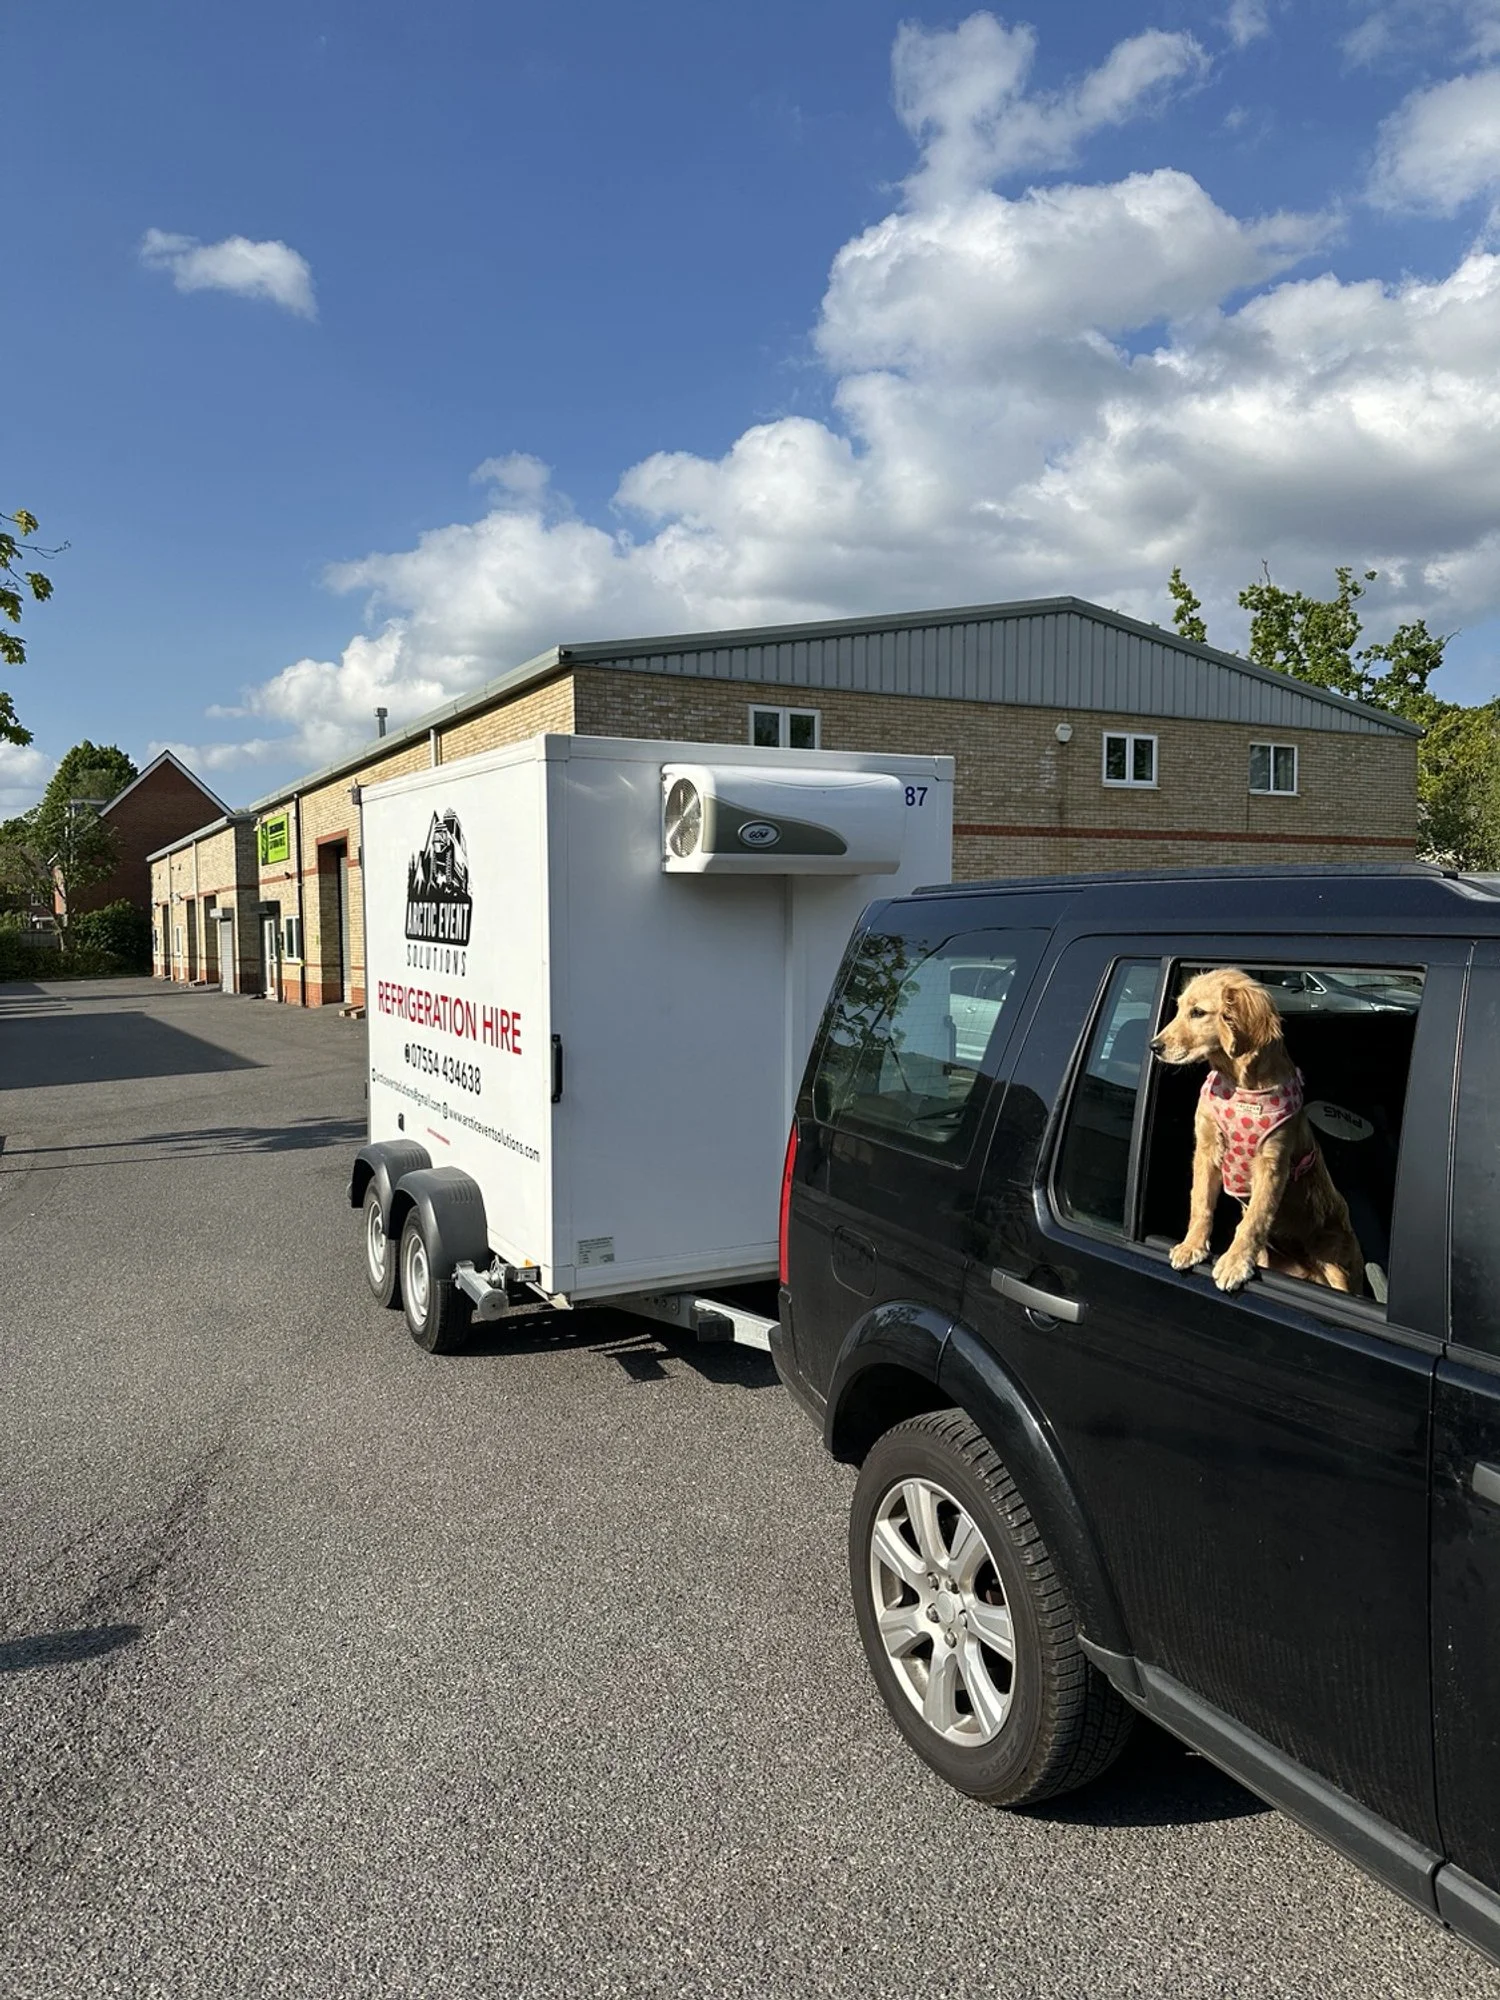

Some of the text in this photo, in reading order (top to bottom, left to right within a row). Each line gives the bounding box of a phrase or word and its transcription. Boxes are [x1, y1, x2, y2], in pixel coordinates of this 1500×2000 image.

[905, 787, 928, 807] 87
[406, 902, 470, 940] ARCTIC EVENT
[406, 943, 467, 977] SOLUTIONS
[378, 980, 522, 1055] REFRIGERATION HIRE
[411, 1043, 481, 1095] 07554 434638
[1323, 1106, 1363, 1129] PING
